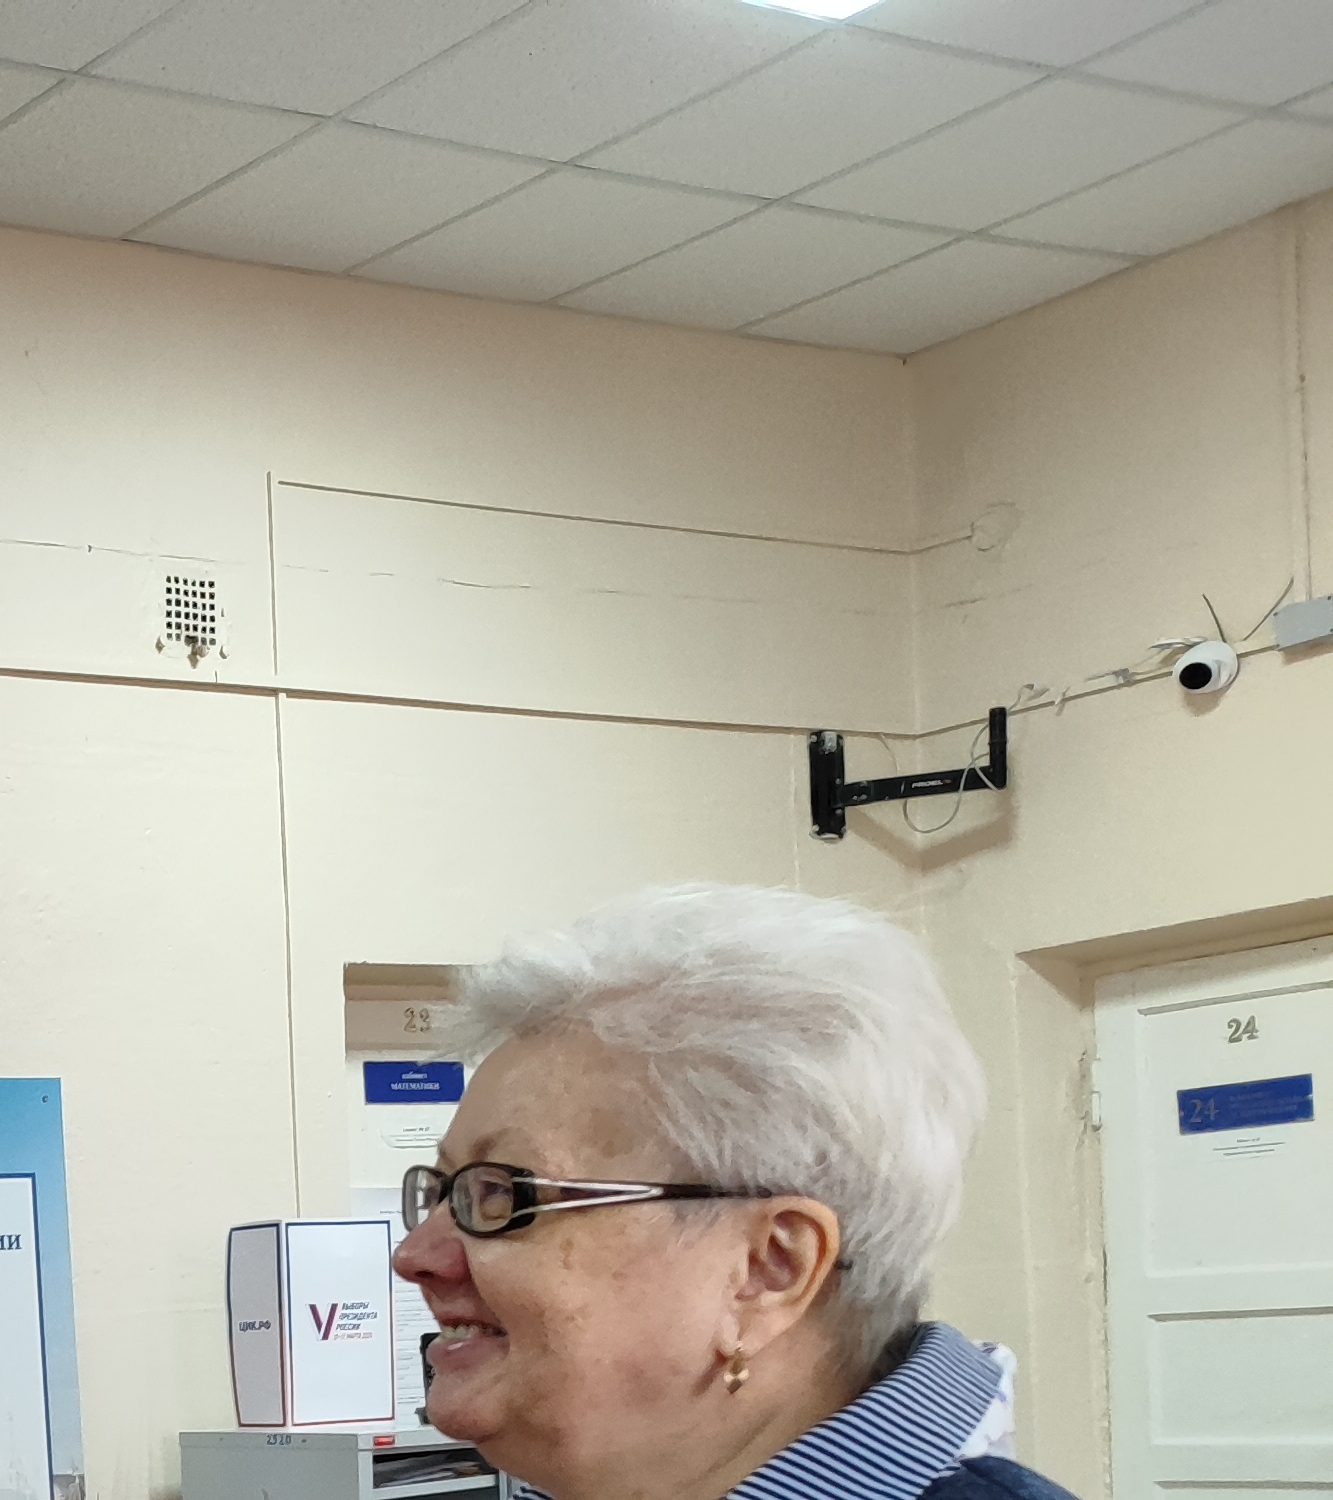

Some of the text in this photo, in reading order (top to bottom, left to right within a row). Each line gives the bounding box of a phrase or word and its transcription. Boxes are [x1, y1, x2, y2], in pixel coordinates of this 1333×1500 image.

[1227, 1015, 1260, 1043] 24
[1188, 1098, 1221, 1123] 24
[266, 1434, 292, 1446] 2520
